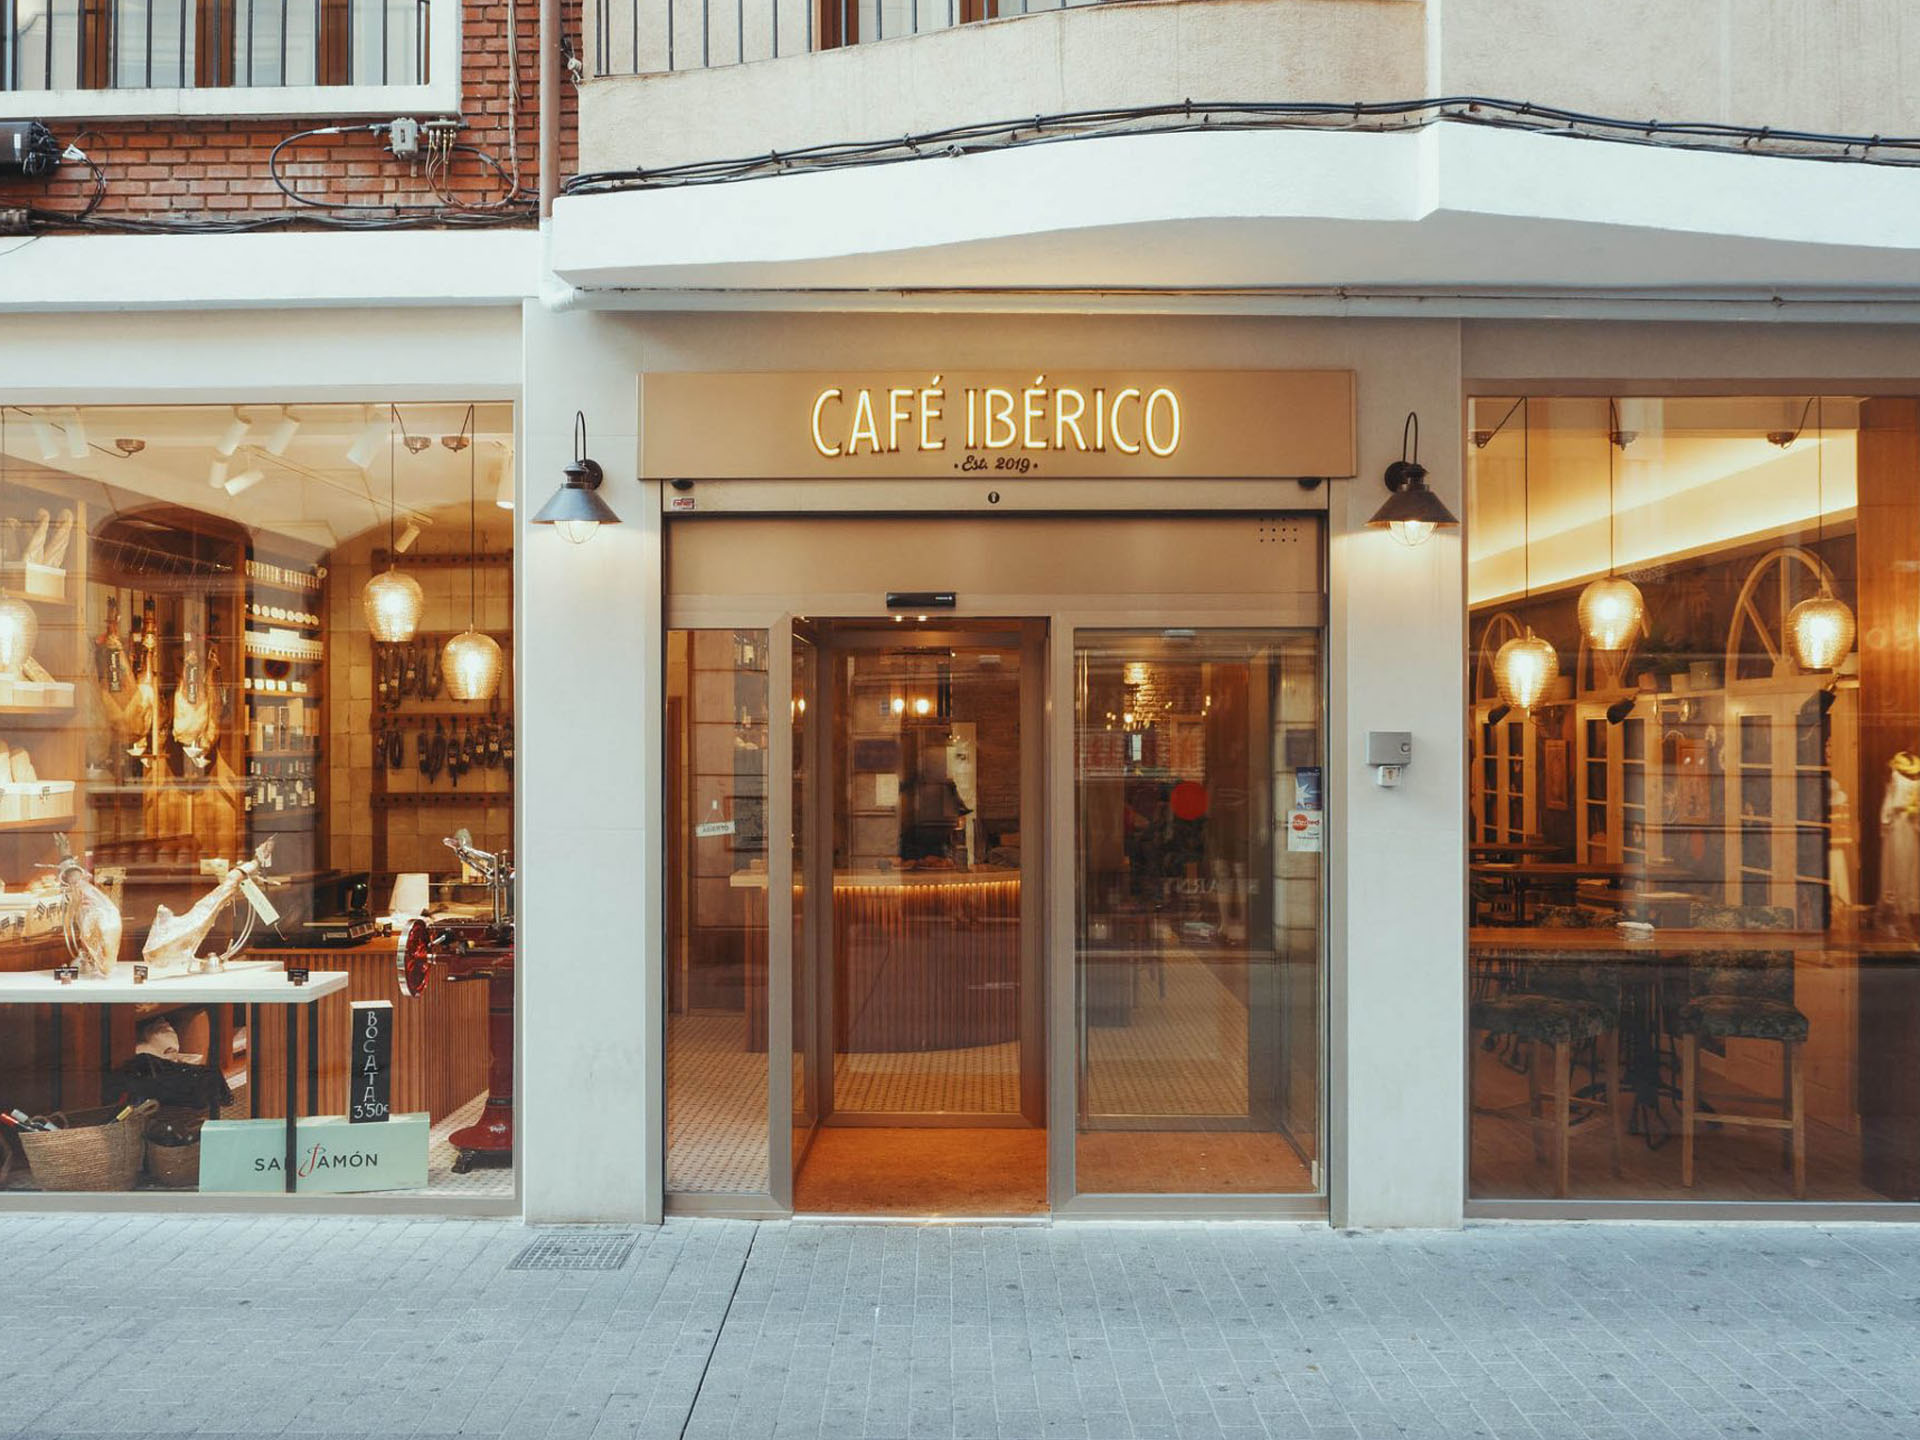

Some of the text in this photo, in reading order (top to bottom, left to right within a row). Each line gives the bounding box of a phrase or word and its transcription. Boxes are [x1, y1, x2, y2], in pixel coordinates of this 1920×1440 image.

[811, 375, 1181, 457] CAFÉ IBÉRICO
[961, 455, 1031, 474] Est. 2019
[362, 1010, 379, 1102] BOCATA
[254, 1142, 378, 1178] SAJAMÓN
